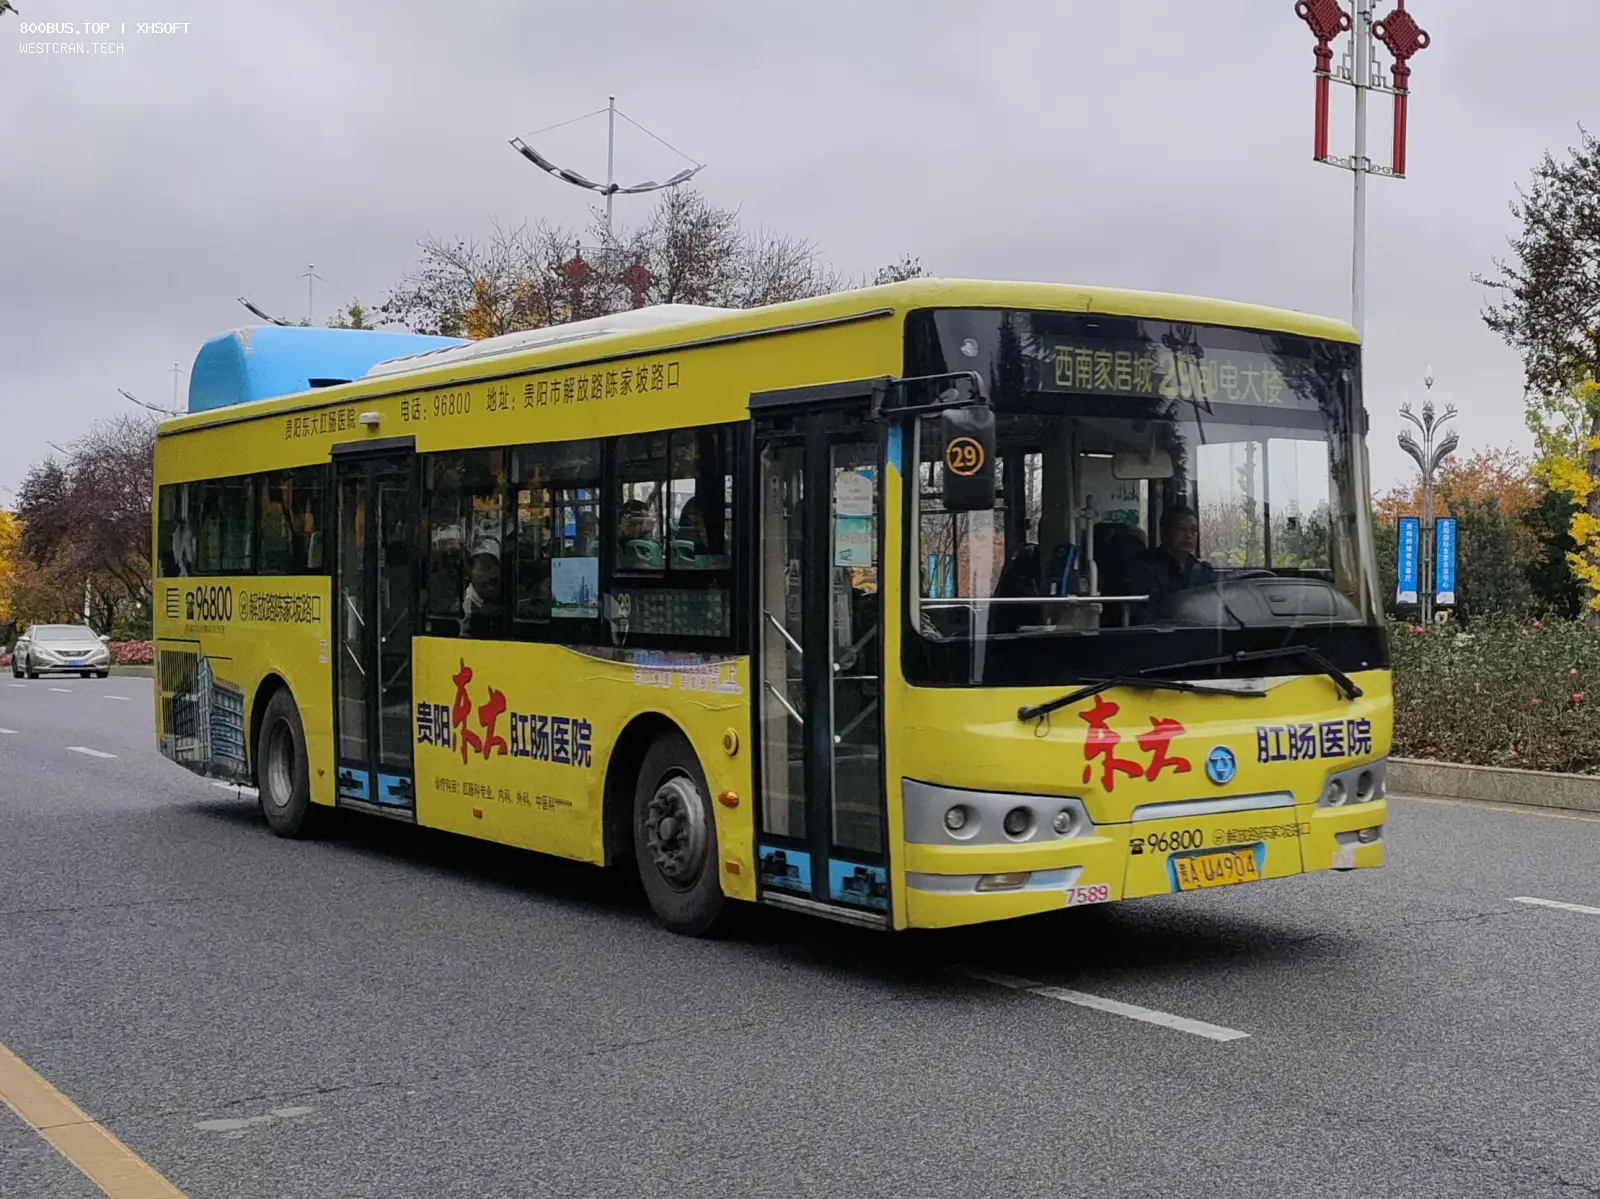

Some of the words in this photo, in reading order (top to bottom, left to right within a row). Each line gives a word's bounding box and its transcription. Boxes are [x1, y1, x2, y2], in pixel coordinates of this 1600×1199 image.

[952, 447, 977, 468] 29
[196, 585, 232, 622] 96800
[1255, 717, 1372, 764] 肛肠医院
[1148, 828, 1203, 853] 96800
[1065, 885, 1108, 904] 7589
